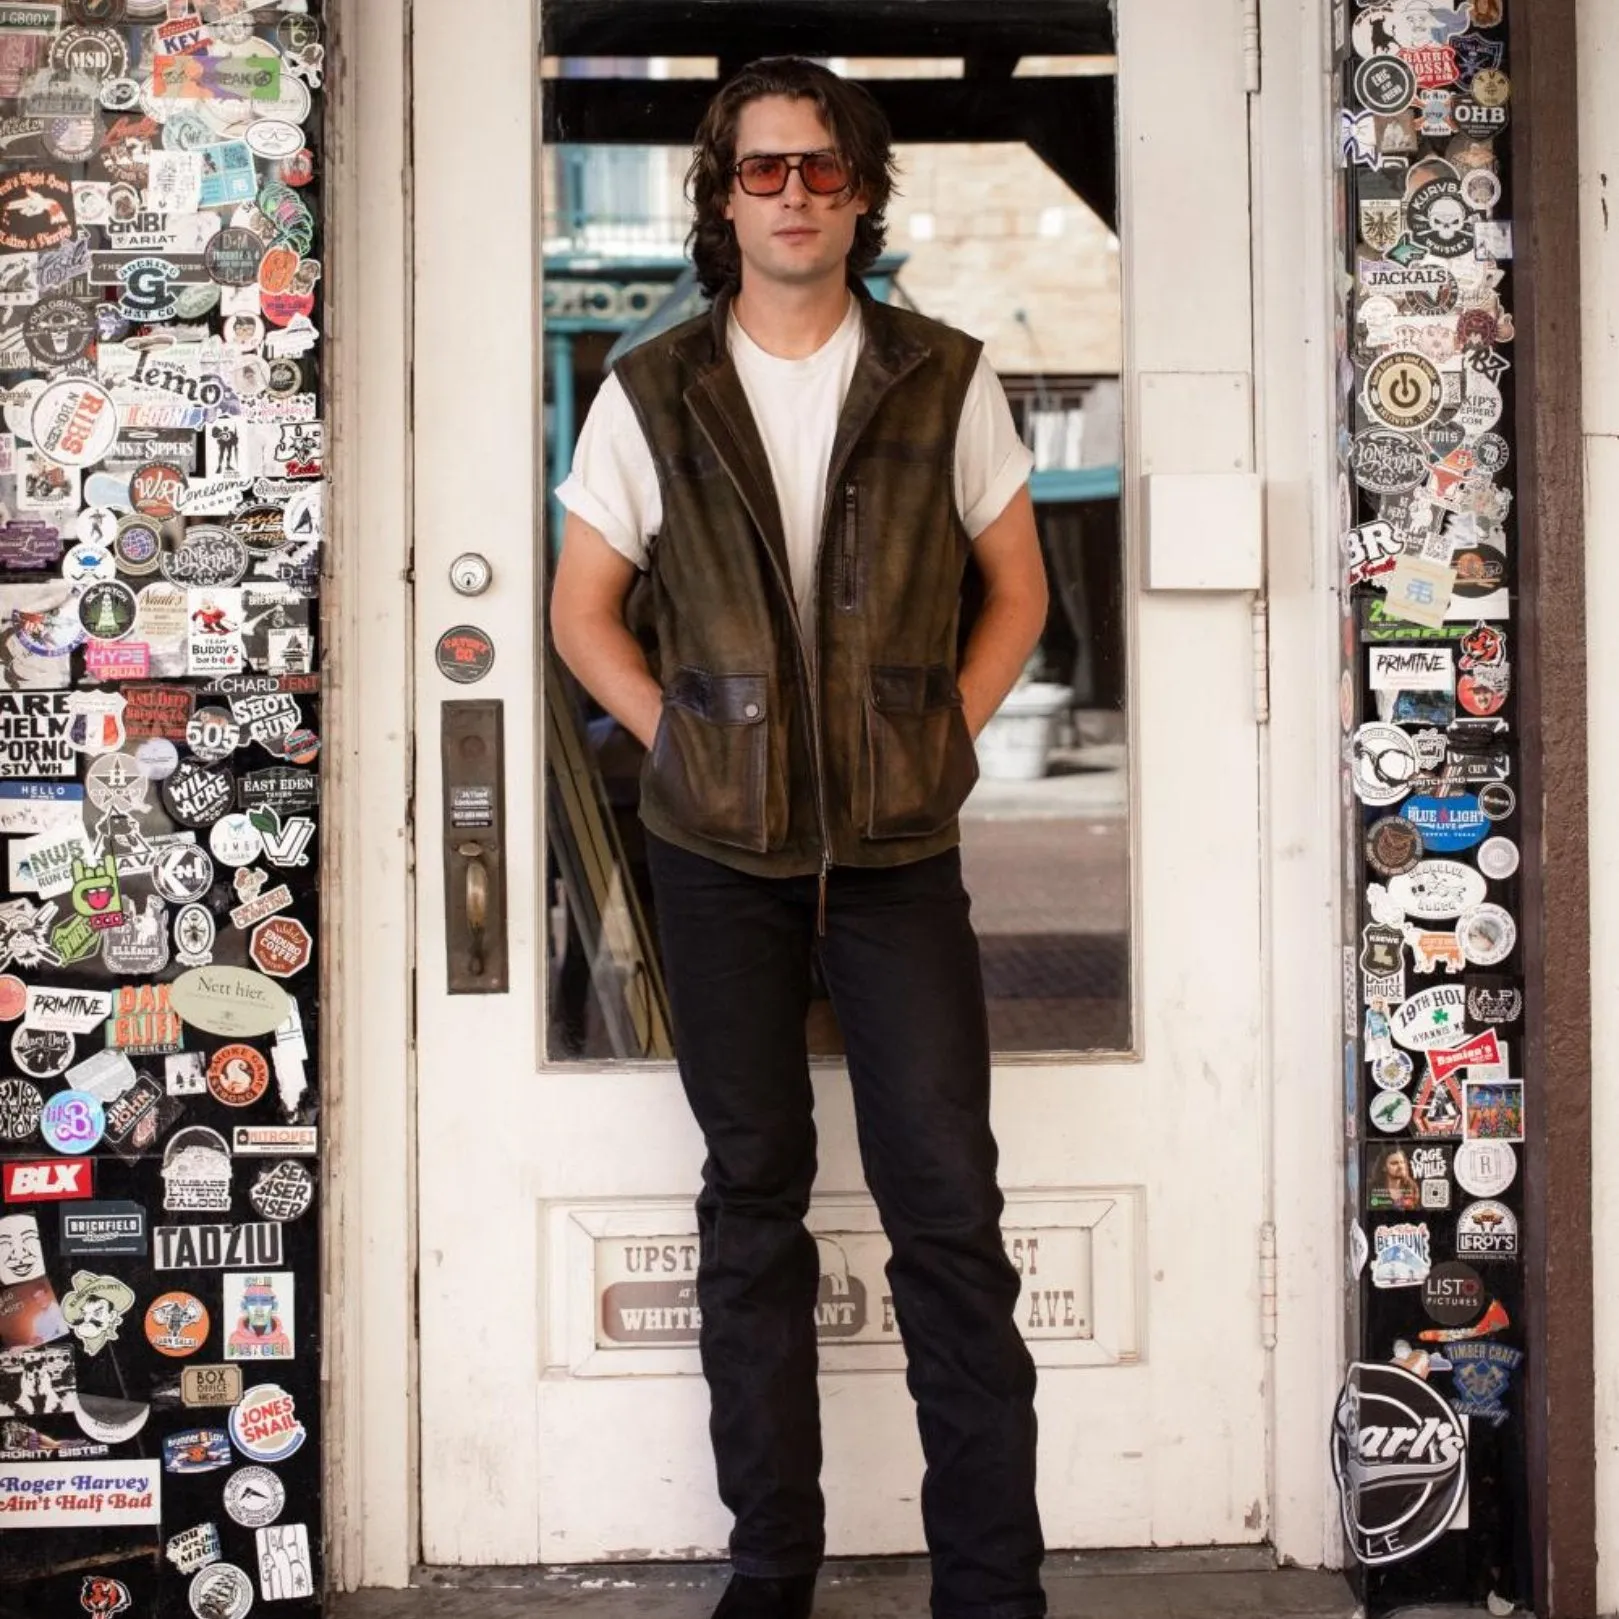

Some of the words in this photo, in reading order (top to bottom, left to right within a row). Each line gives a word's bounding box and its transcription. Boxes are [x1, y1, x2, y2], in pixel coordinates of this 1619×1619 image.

[163, 30, 200, 55] KEY
[1454, 105, 1507, 125] OHB
[129, 234, 176, 246] ARIAT
[1425, 237, 1470, 256] WHISKEY
[1367, 269, 1447, 286] JACKALS
[90, 649, 146, 664] HYPE
[191, 644, 240, 655] BUDDY'S
[1376, 652, 1447, 676] PRIMITIVE
[232, 693, 291, 725] SHOT
[186, 720, 241, 748] 505
[249, 711, 299, 741] GUN
[20, 785, 66, 796] HELLO
[243, 779, 276, 792] EAST
[279, 778, 315, 791] EDEN
[176, 774, 232, 819] ACRE
[1408, 808, 1437, 823] BLUE
[1449, 808, 1486, 824] LIGHT
[198, 975, 232, 996] Nett
[234, 978, 268, 1002] hier.
[1365, 984, 1403, 998] HOUSE
[33, 994, 106, 1017] PRIMITIVE
[1398, 993, 1431, 1030] 19TH
[1412, 1147, 1444, 1164] CAGE
[9, 1164, 85, 1196] BLX
[168, 1188, 227, 1197] LIVERY
[166, 1197, 229, 1209] SALOON
[70, 1219, 138, 1233] BRICKFIELD
[156, 1222, 280, 1268] TADZIU
[1460, 1234, 1514, 1251] LEROY'S
[1027, 1291, 1086, 1327] AVE.
[1426, 1297, 1479, 1307] PICTURES
[196, 1370, 226, 1385] BOX
[240, 1396, 294, 1429] JONES
[243, 1413, 298, 1444] SNAIL
[58, 1444, 109, 1458] SISTER
[0, 1477, 66, 1495] Roger
[71, 1475, 149, 1492] Harvey
[0, 1495, 52, 1512] Ain't
[55, 1494, 105, 1513] Half
[107, 1493, 152, 1510] Bad
[171, 1529, 199, 1550] you
[182, 1539, 200, 1553] are
